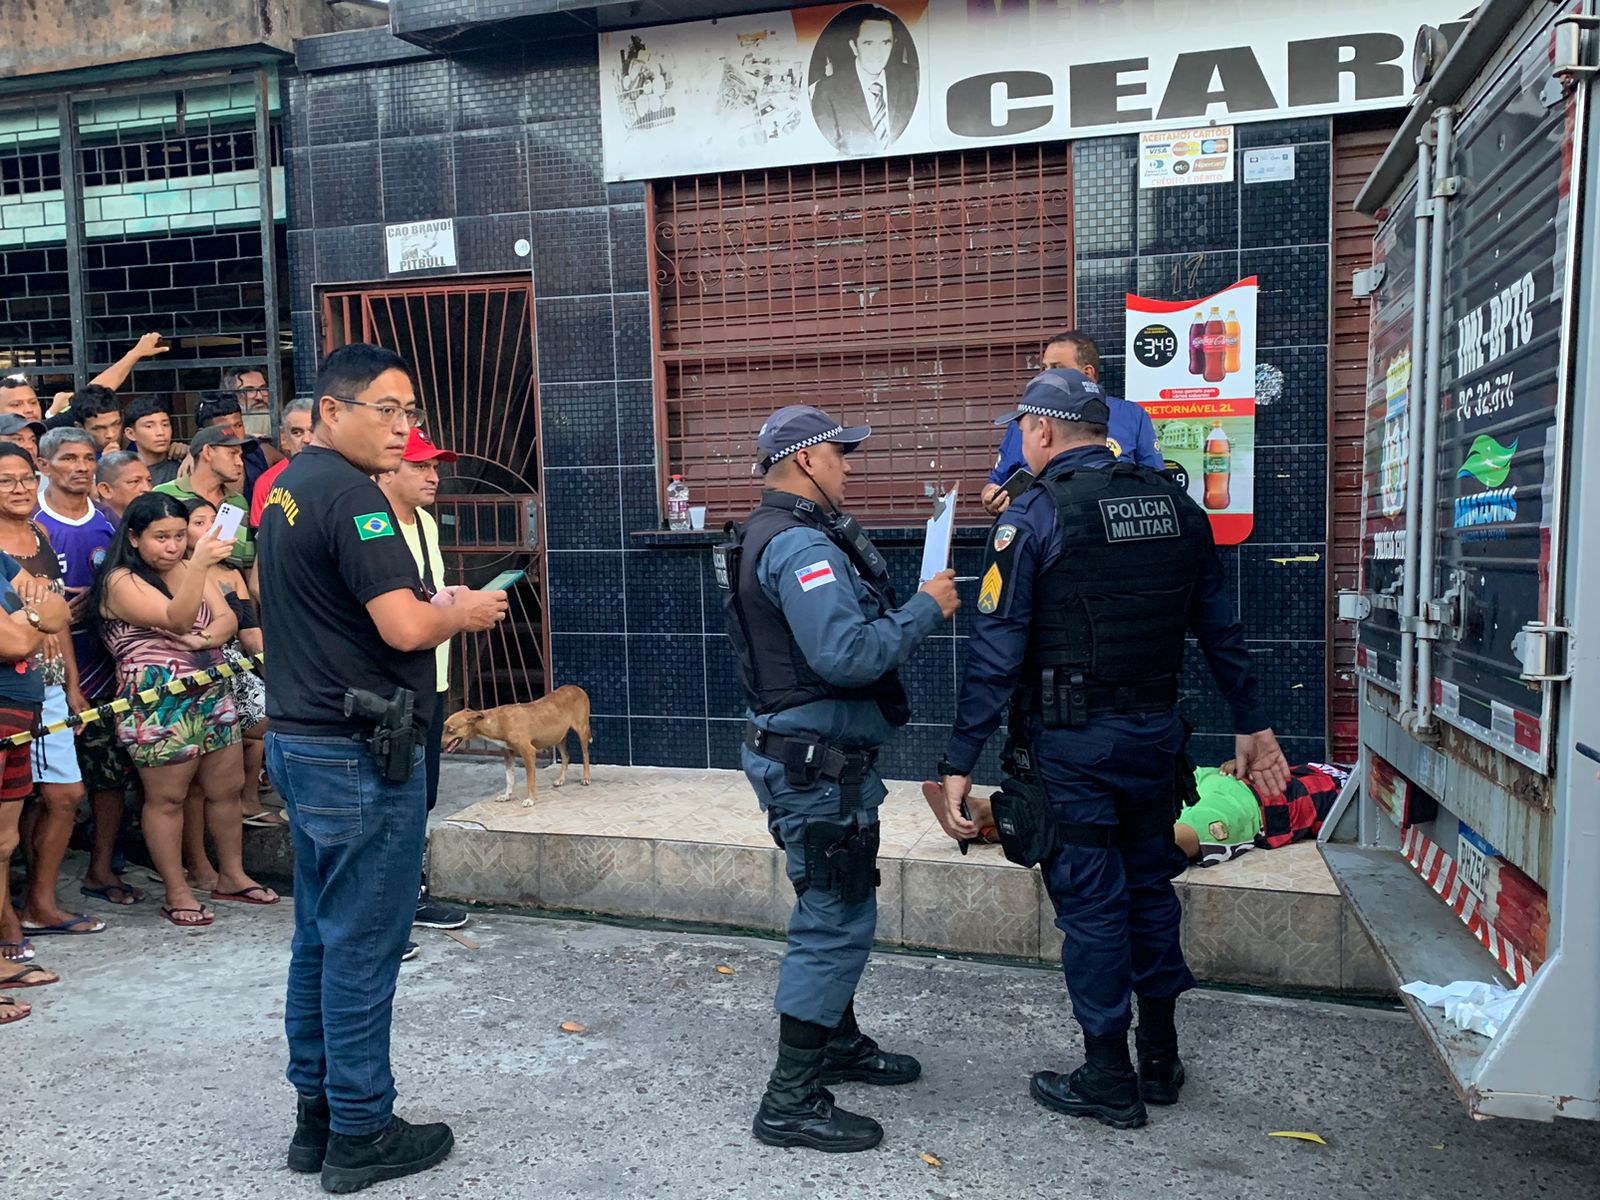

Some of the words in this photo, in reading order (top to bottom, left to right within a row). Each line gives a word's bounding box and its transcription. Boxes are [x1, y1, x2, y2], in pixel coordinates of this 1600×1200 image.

[1143, 131, 1190, 143] ACEITAMOS
[1193, 127, 1231, 138] CARTÕES
[1152, 176, 1185, 186] CRÉDITO
[1194, 174, 1223, 183] DÉBITO
[412, 221, 450, 234] BRAVO!
[400, 257, 445, 270] PITBULL
[1457, 271, 1535, 379] IML-DPTC
[1145, 402, 1217, 415] RETORNÁVEL
[1219, 403, 1234, 412] 2L
[1457, 387, 1473, 422] PC
[1107, 498, 1170, 519] POLÍCIA
[1454, 485, 1518, 529] AMAZONAS
[1111, 517, 1174, 539] MILITAR
